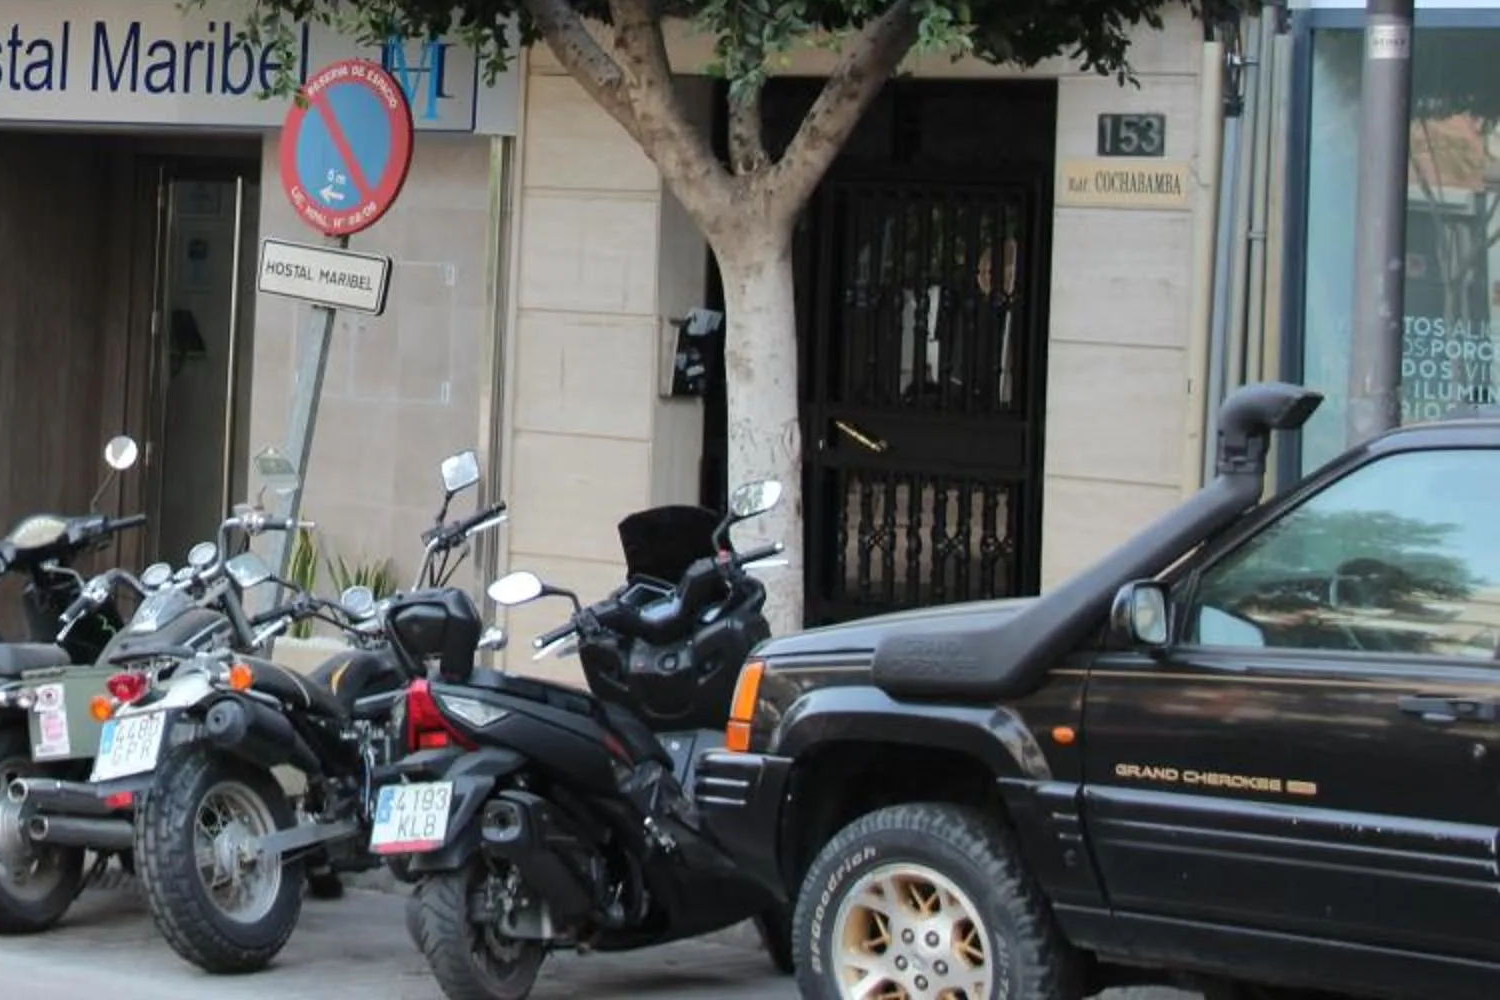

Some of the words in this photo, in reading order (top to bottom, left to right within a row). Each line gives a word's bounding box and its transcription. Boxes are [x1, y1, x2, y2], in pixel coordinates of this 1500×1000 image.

[91, 19, 309, 95] Maribel
[1101, 116, 1162, 154] 153
[1095, 170, 1181, 195] COCHABAMBA
[265, 261, 313, 280] HOSTAL
[319, 267, 372, 291] MARIBEL
[1403, 316, 1445, 337] TOS
[1402, 358, 1452, 379] DOS
[1115, 763, 1179, 782] GRAND
[1182, 769, 1282, 793] CHEROKEE
[396, 812, 437, 838] KLB
